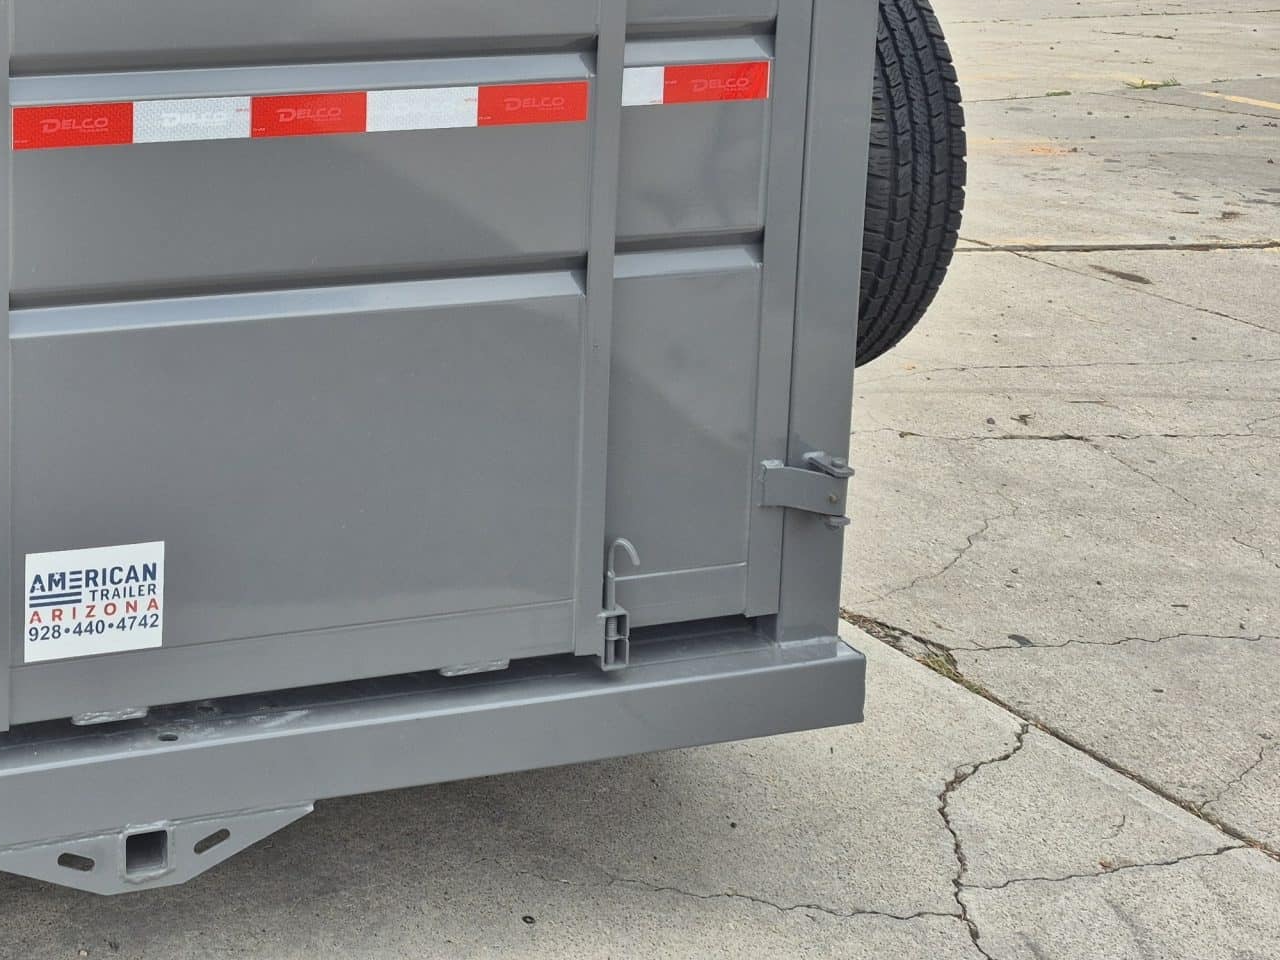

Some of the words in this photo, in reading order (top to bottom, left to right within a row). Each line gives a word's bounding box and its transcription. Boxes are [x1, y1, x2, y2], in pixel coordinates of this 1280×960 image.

[694, 78, 749, 92] DELCO
[503, 96, 565, 111] DELCO
[276, 107, 342, 122] DELCO
[40, 117, 108, 133] DELCO
[30, 562, 157, 594] AMERICAN
[89, 583, 157, 602] TRAILER
[29, 598, 159, 625] ARIZONA
